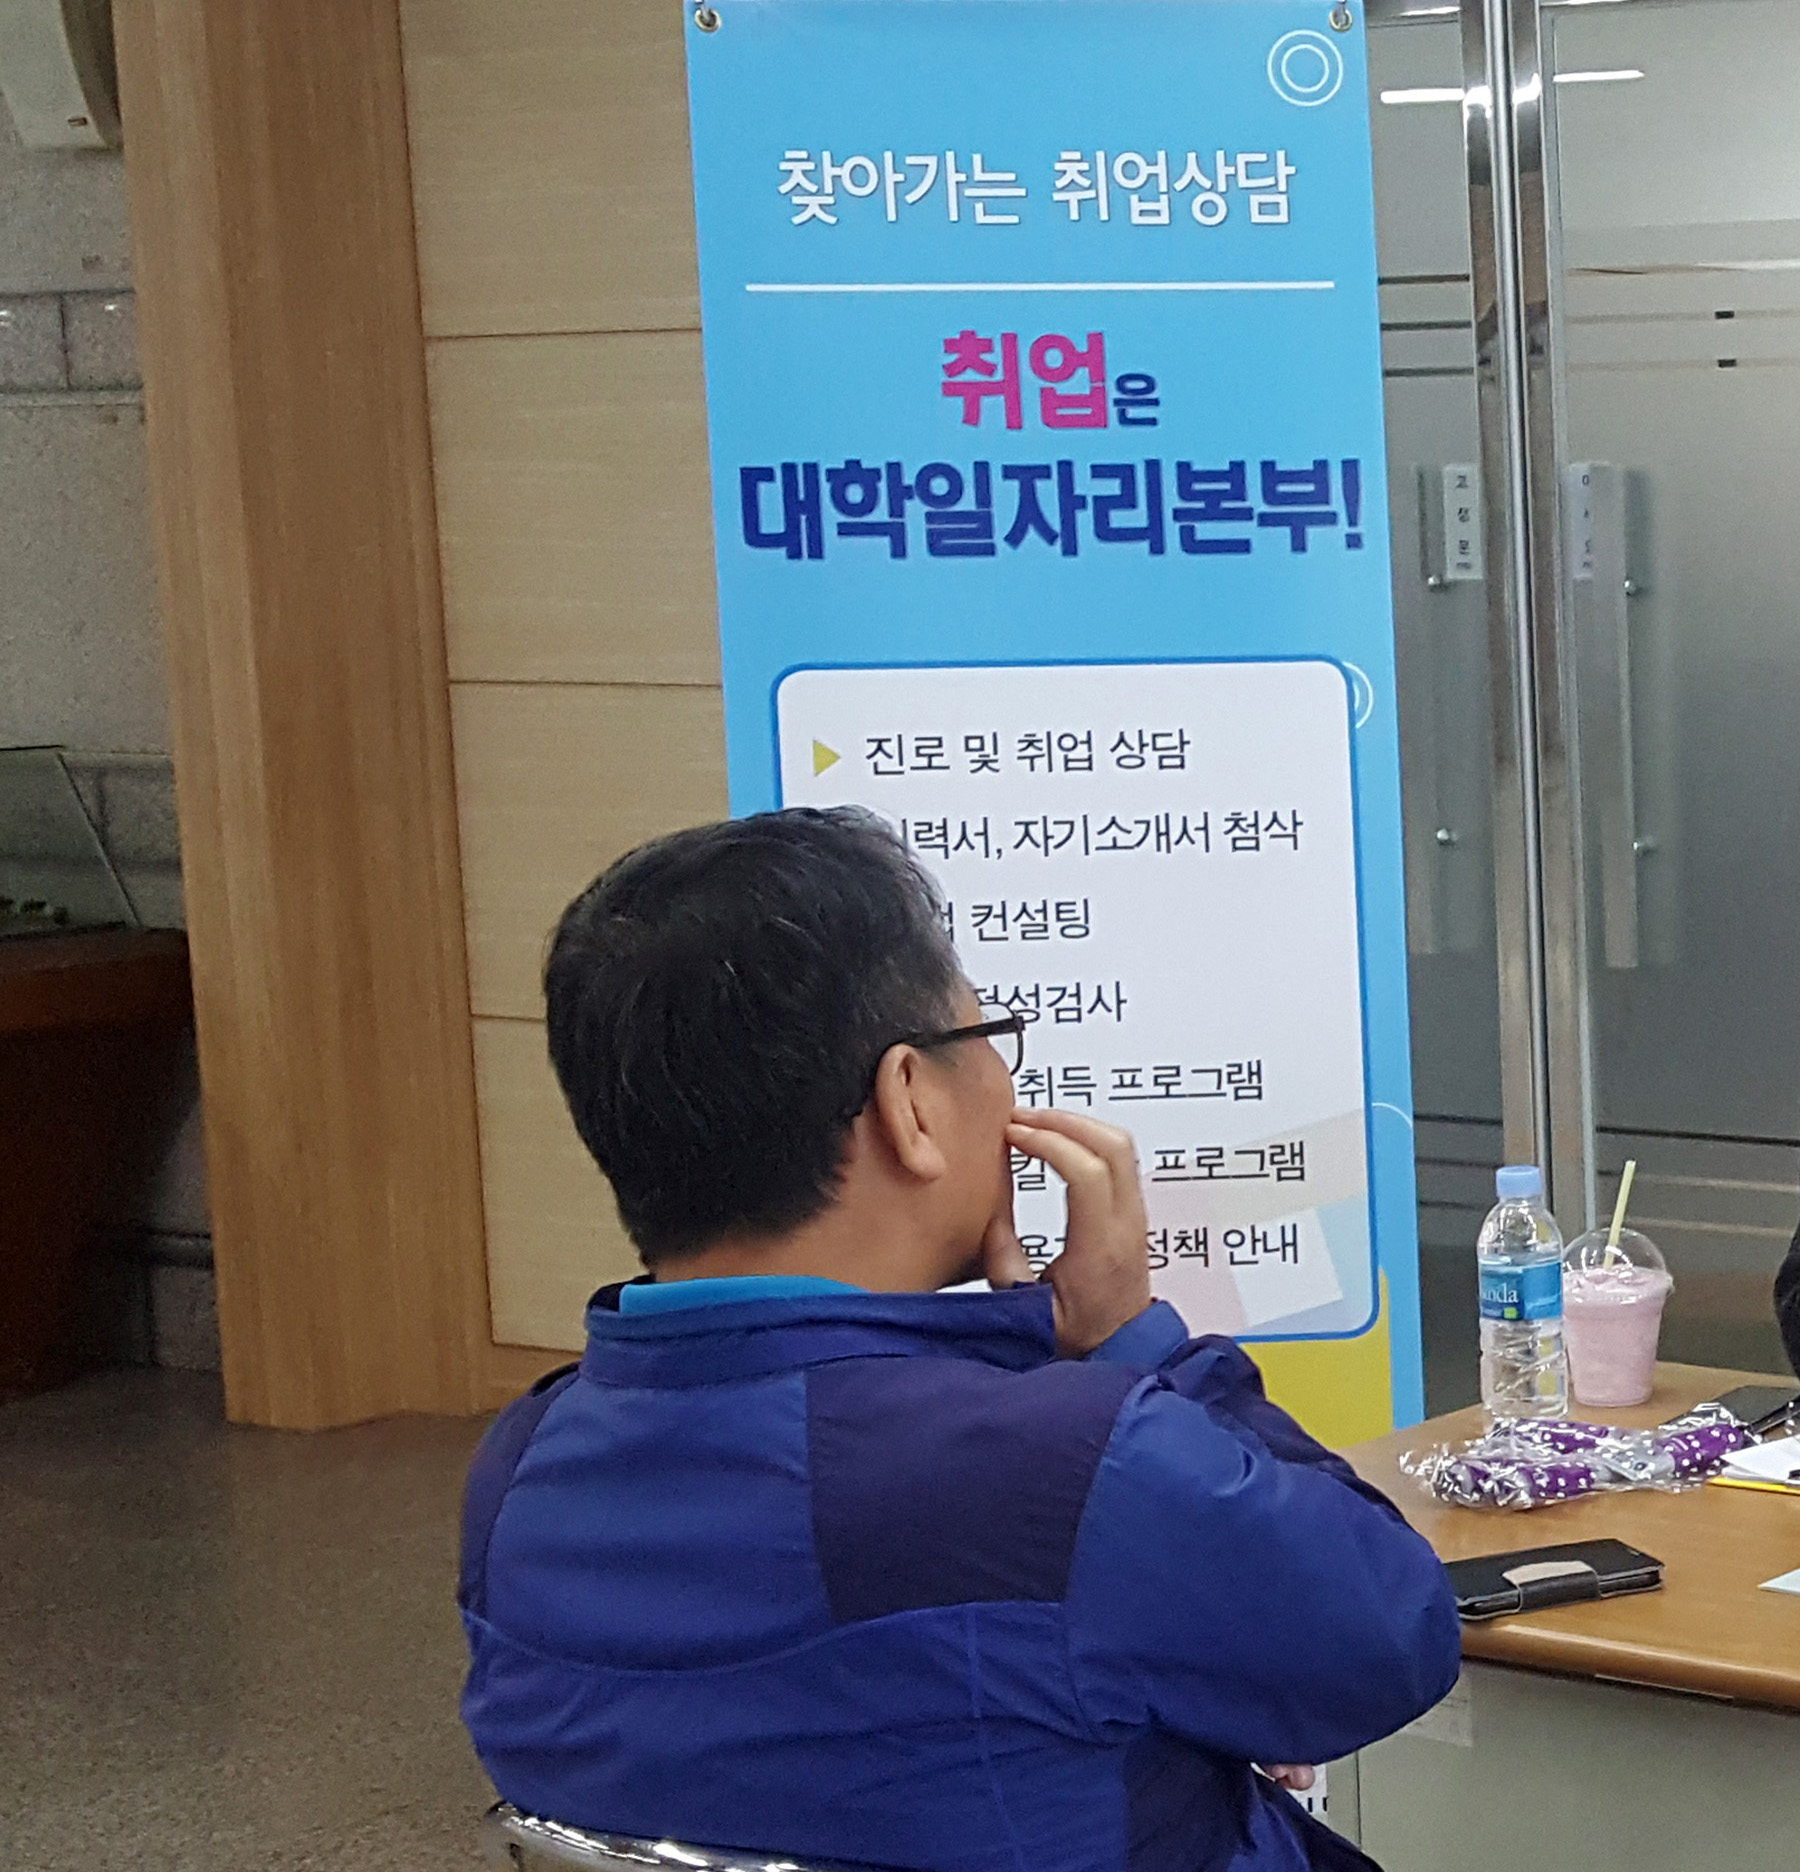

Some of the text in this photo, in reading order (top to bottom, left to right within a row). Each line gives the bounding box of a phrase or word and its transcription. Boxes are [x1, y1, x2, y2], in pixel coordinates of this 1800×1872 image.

[779, 151, 1295, 225] 찾아가는 취업상담
[942, 330, 1160, 430] 취업은
[740, 459, 1361, 560] 대학일자리본부!
[866, 728, 1191, 775] 진로 및 취업 상담
[1013, 812, 1210, 857] 자기소개서
[1223, 809, 1303, 852] 첨삭
[971, 898, 1090, 941] 컨설팅
[1018, 1060, 1262, 1108] 취득 프로그램
[1152, 1140, 1305, 1182] 프로그램
[1223, 1223, 1298, 1265] 안내
